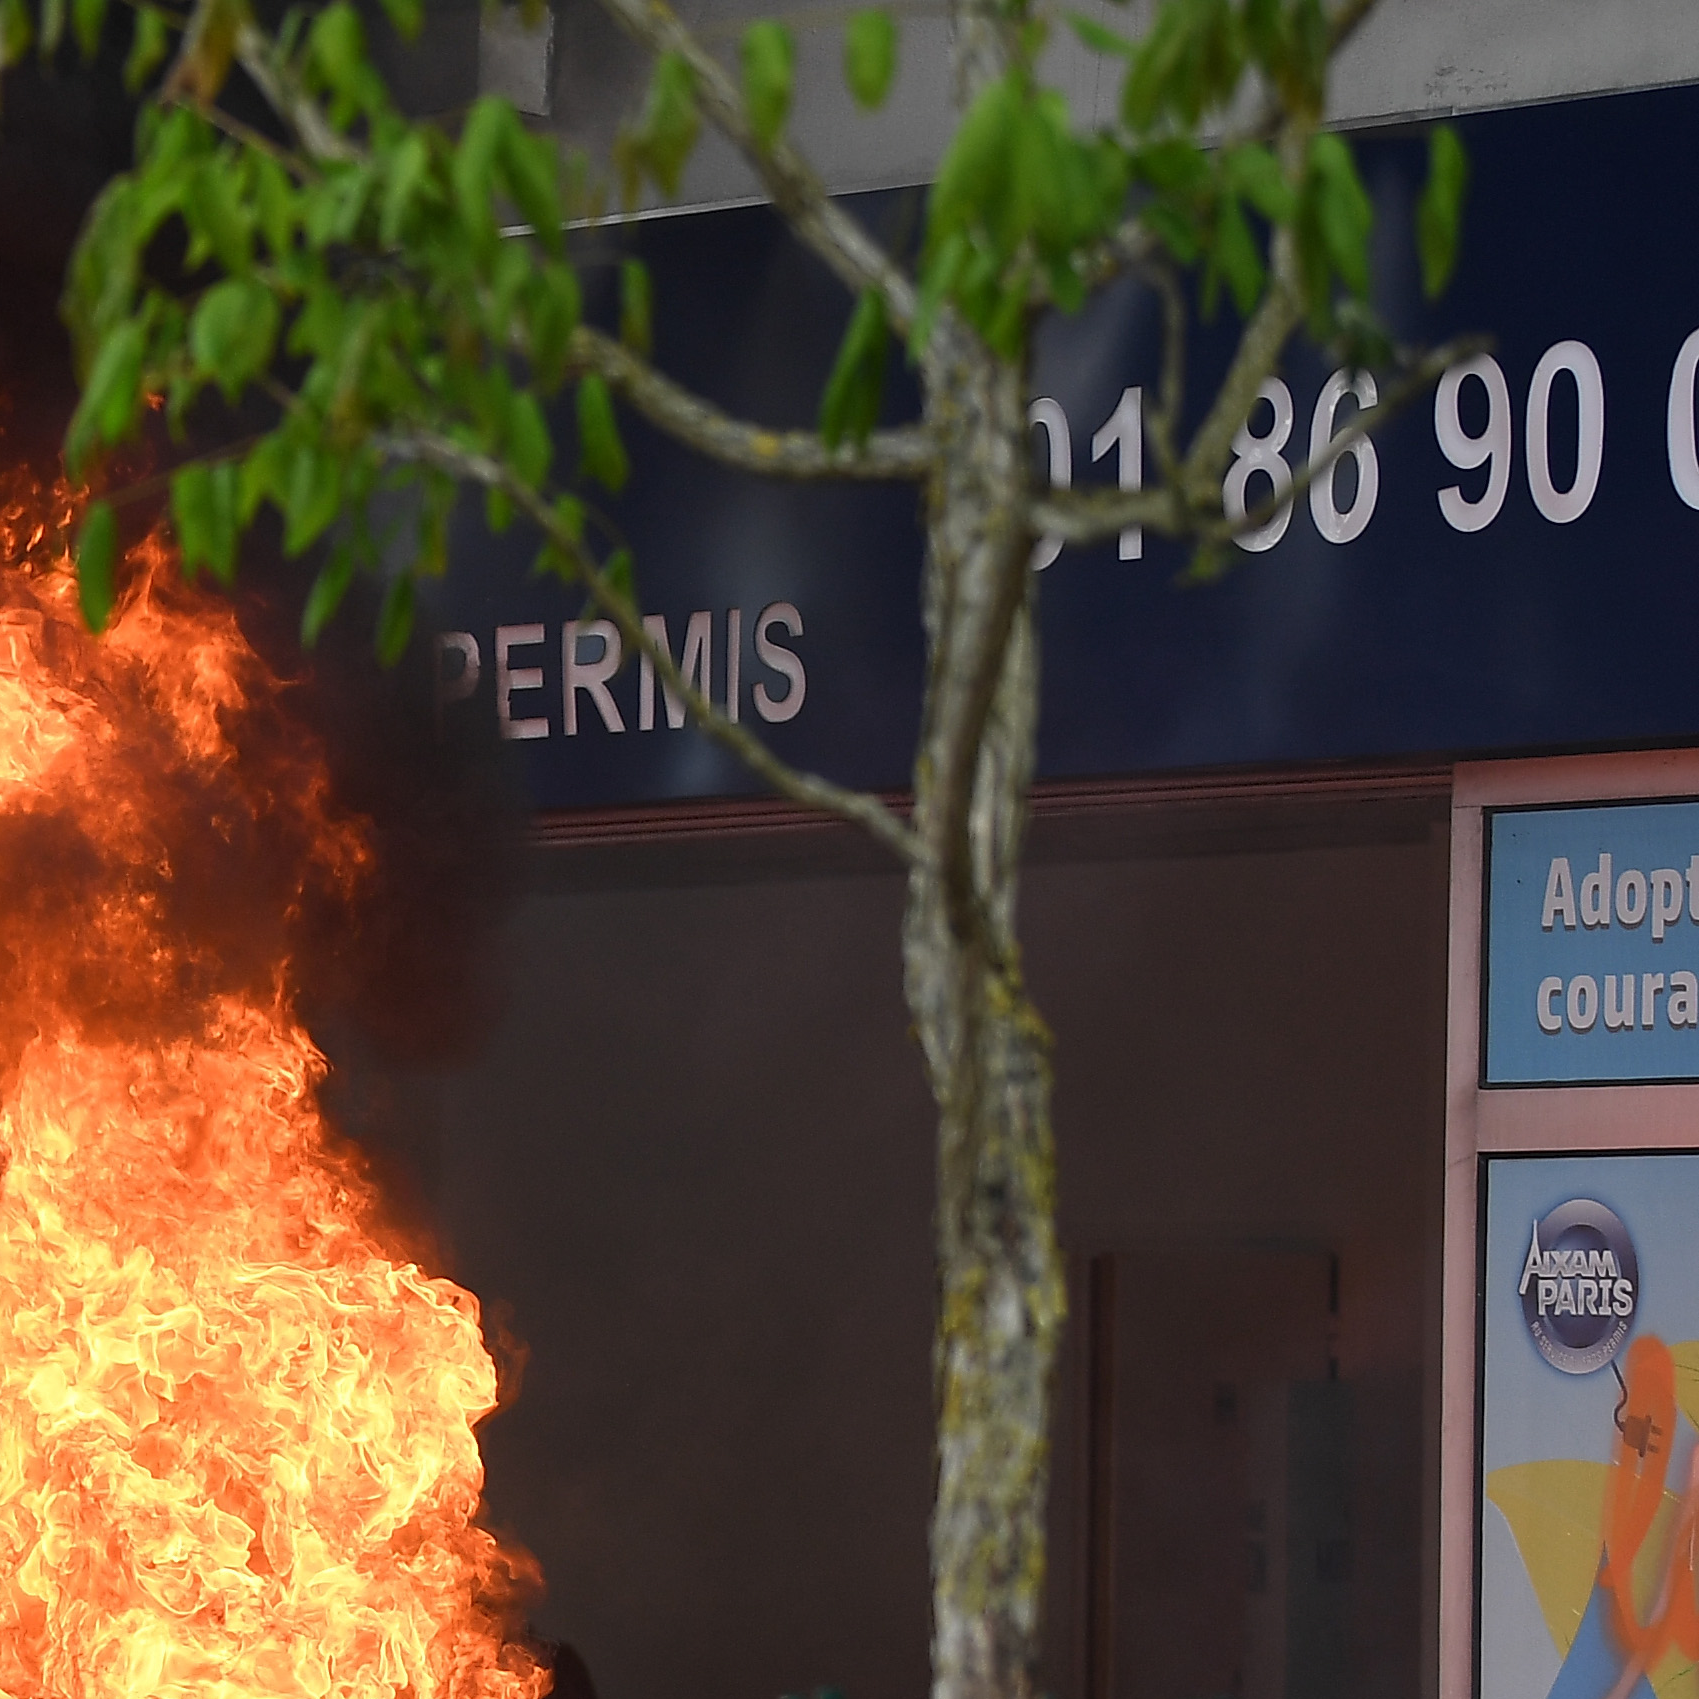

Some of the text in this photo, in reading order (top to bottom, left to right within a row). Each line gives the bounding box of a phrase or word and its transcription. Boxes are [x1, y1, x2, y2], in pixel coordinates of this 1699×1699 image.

[1222, 366, 1379, 553] 86
[1435, 340, 1604, 532] 90
[436, 602, 806, 742] PERMIS
[1536, 970, 1699, 1036] coura
[1519, 1219, 1618, 1294] AIXAM
[1537, 1279, 1634, 1317] PARIS
